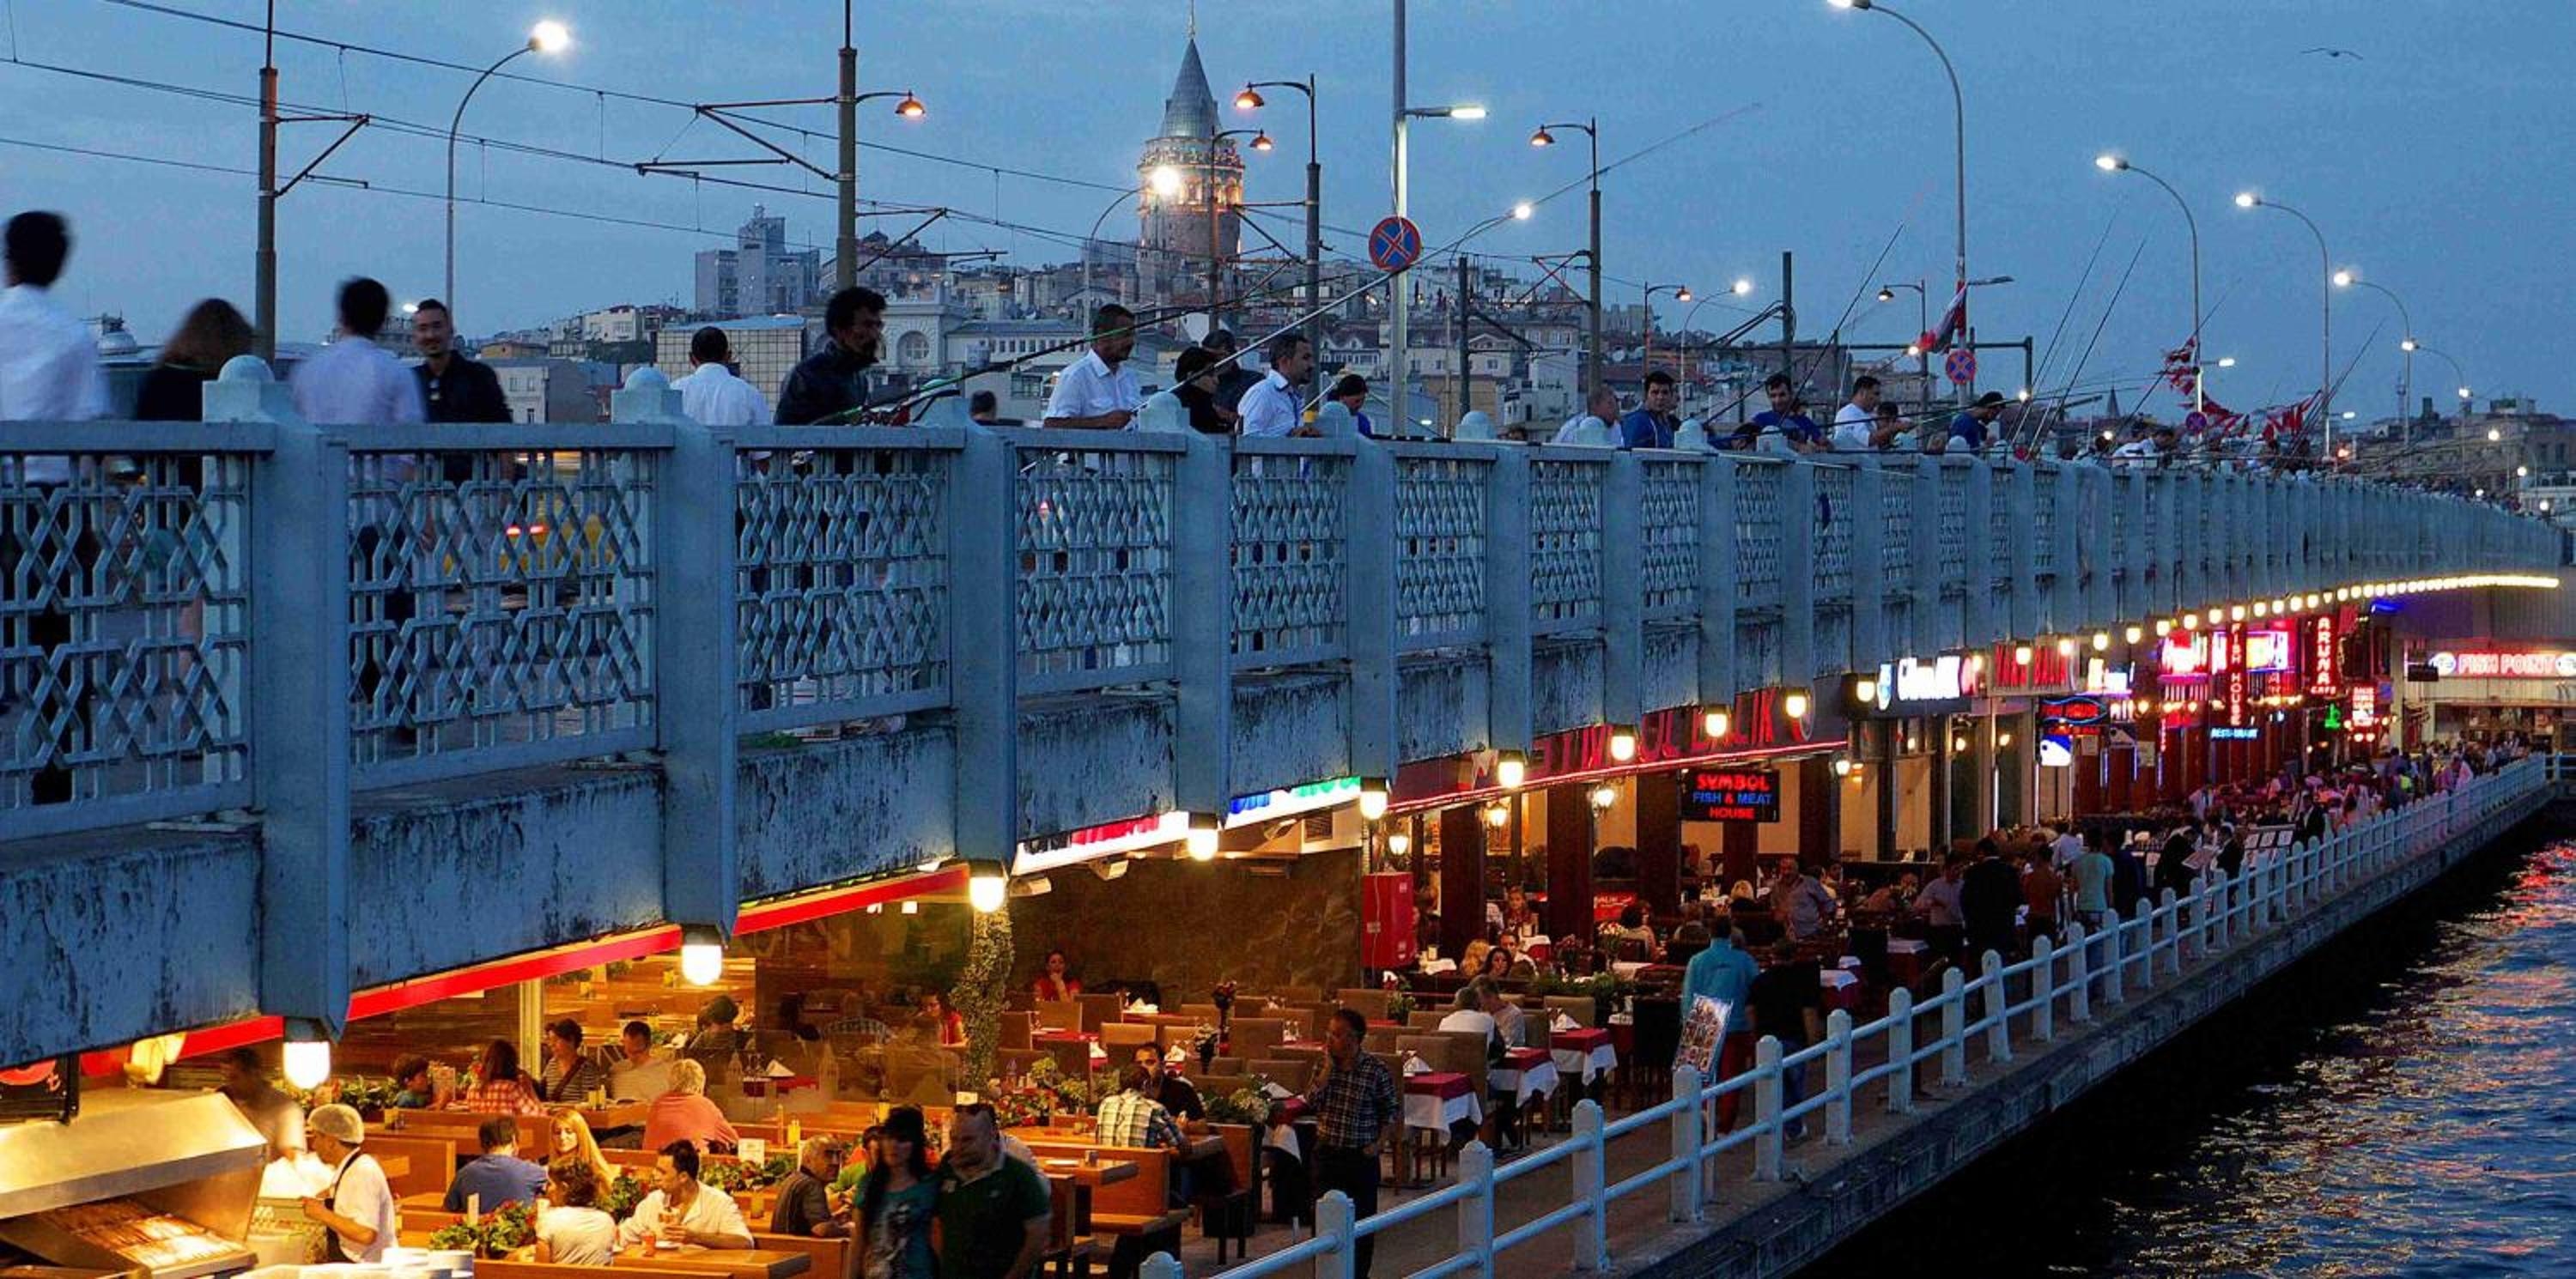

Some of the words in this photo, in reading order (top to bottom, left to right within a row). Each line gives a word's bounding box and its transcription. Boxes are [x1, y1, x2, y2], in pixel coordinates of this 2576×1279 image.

[2231, 622, 2242, 664] FISH
[2317, 617, 2331, 684] ARUNA
[2458, 653, 2499, 674] FISH
[2500, 653, 2556, 674] POINT
[2230, 673, 2242, 725] HOUSE
[1691, 688, 1777, 749] BLIK
[1692, 792, 1722, 803] FISH
[1725, 793, 1733, 803] &
[1737, 793, 1771, 803] MEAT
[1697, 774, 1770, 791] SYMBOL
[1710, 807, 1754, 819] HOUSE
